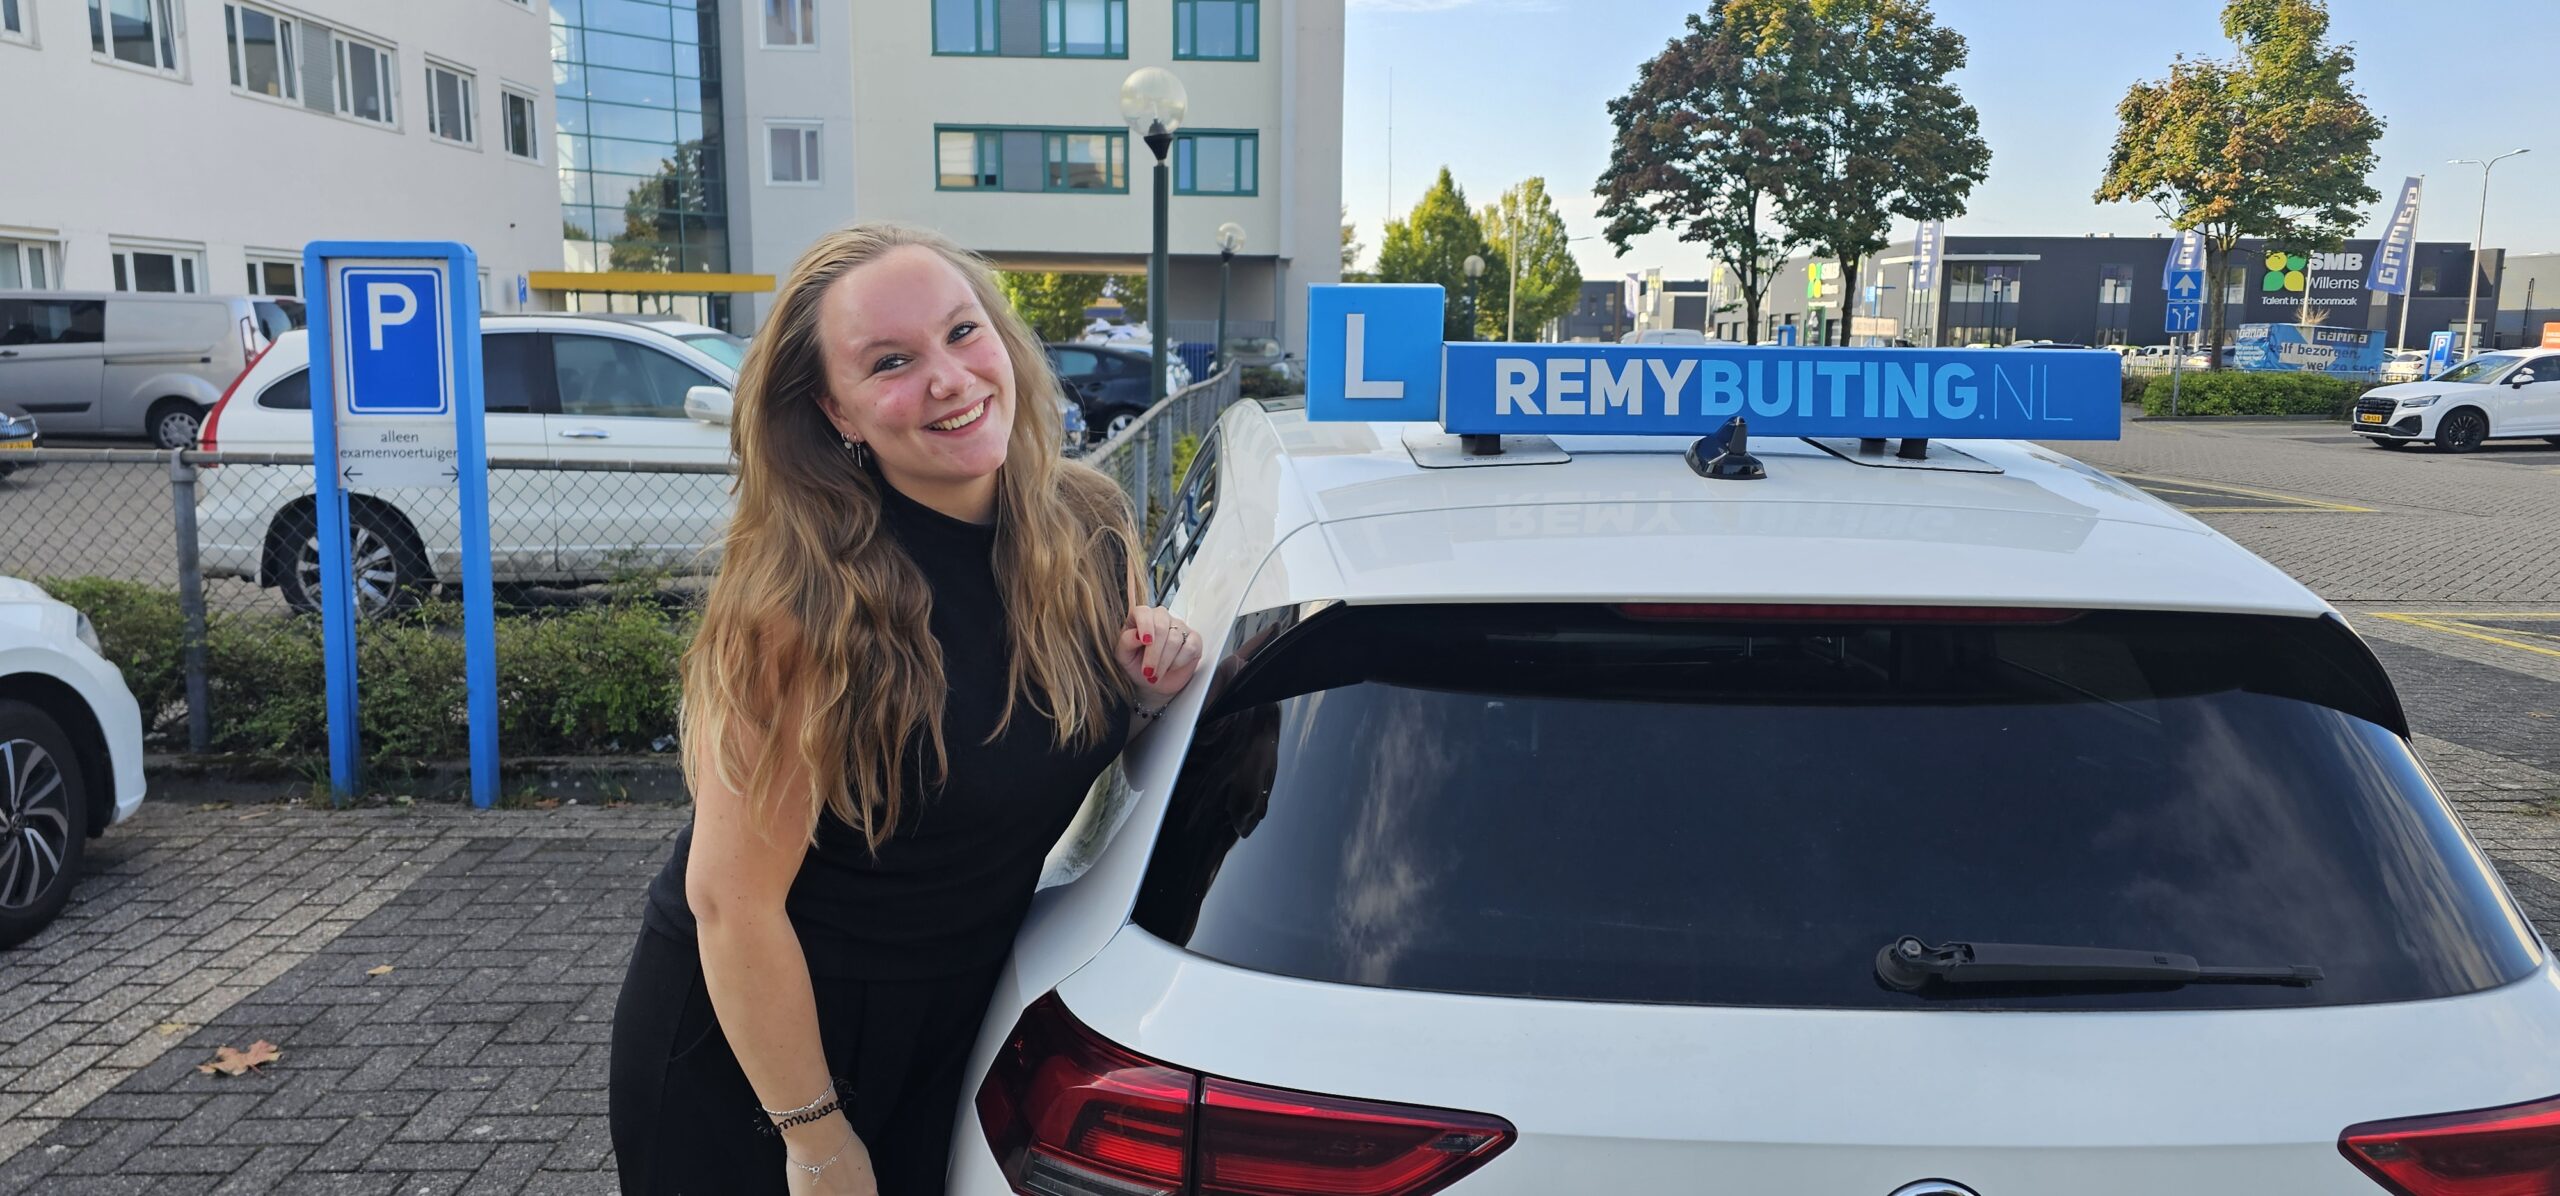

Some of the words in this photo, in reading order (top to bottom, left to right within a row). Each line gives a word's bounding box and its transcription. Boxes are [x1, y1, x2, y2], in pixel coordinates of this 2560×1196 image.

[2307, 252, 2363, 271] SMB
[2305, 276, 2360, 289] Willems
[2261, 296, 2289, 305] Talent
[2290, 296, 2299, 305] in
[367, 282, 418, 351] P
[1345, 314, 1404, 399] L
[2307, 361, 2329, 371] wel
[2332, 364, 2348, 372] zo
[1495, 357, 2073, 422] REMYBUITING.NL
[381, 430, 419, 442] alleen
